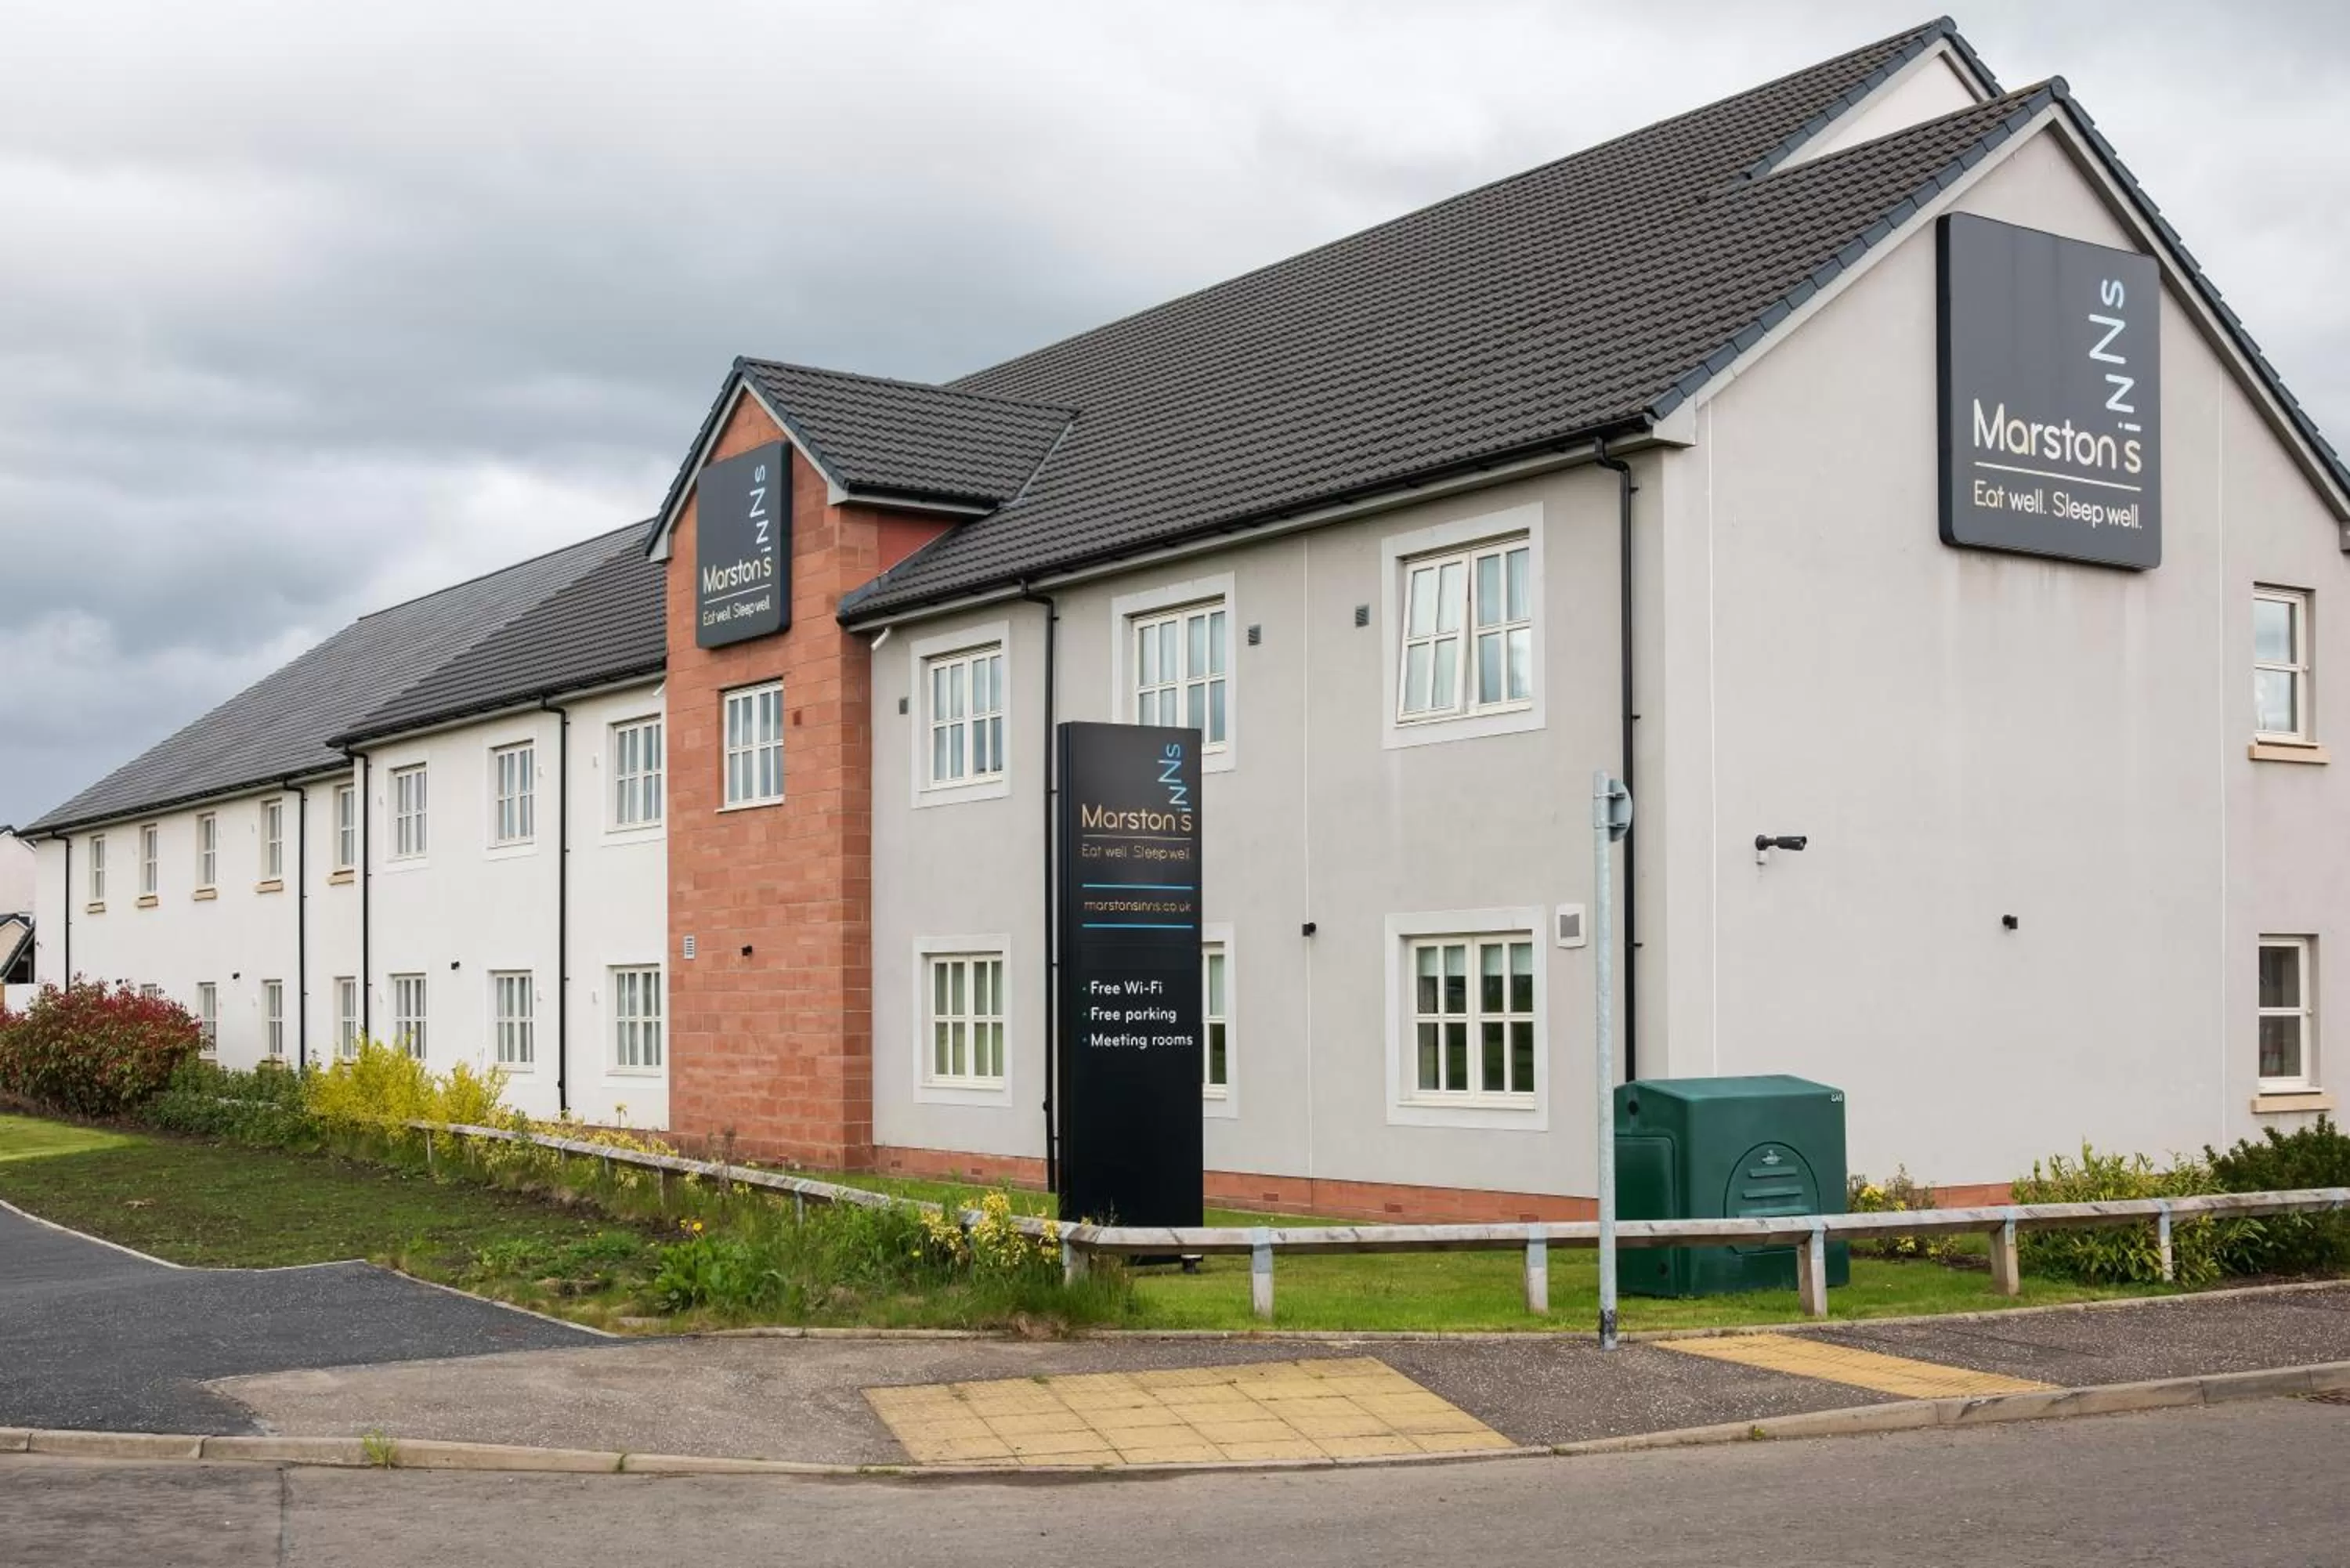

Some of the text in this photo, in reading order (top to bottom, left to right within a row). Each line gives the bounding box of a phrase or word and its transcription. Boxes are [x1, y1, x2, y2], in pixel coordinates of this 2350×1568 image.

[1973, 479, 2143, 530] Eat well. Sleep well.
[703, 611, 715, 627] Eat
[732, 602, 754, 618] Sleep
[1081, 844, 1101, 858] Eat
[1133, 845, 1168, 863] Sleep
[1090, 981, 1162, 995] Free Wi-Fi
[1090, 1006, 1177, 1024] Free parking
[1090, 1033, 1194, 1050] Meeting rooms
